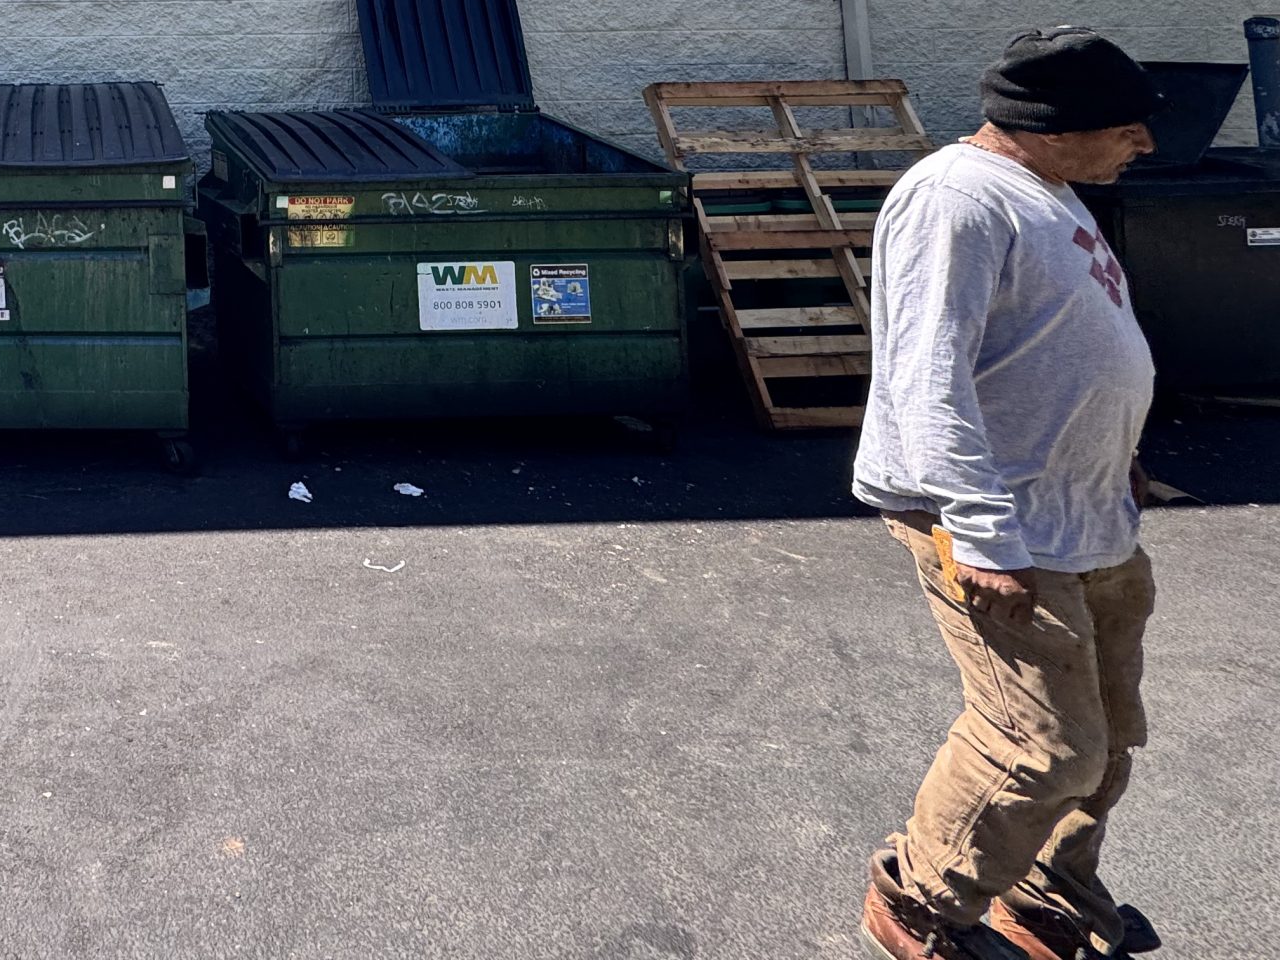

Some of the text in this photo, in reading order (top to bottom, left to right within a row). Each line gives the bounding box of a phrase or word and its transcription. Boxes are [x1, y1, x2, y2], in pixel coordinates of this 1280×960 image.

[430, 265, 499, 286] WM
[433, 300, 502, 310] 800 808 5901
